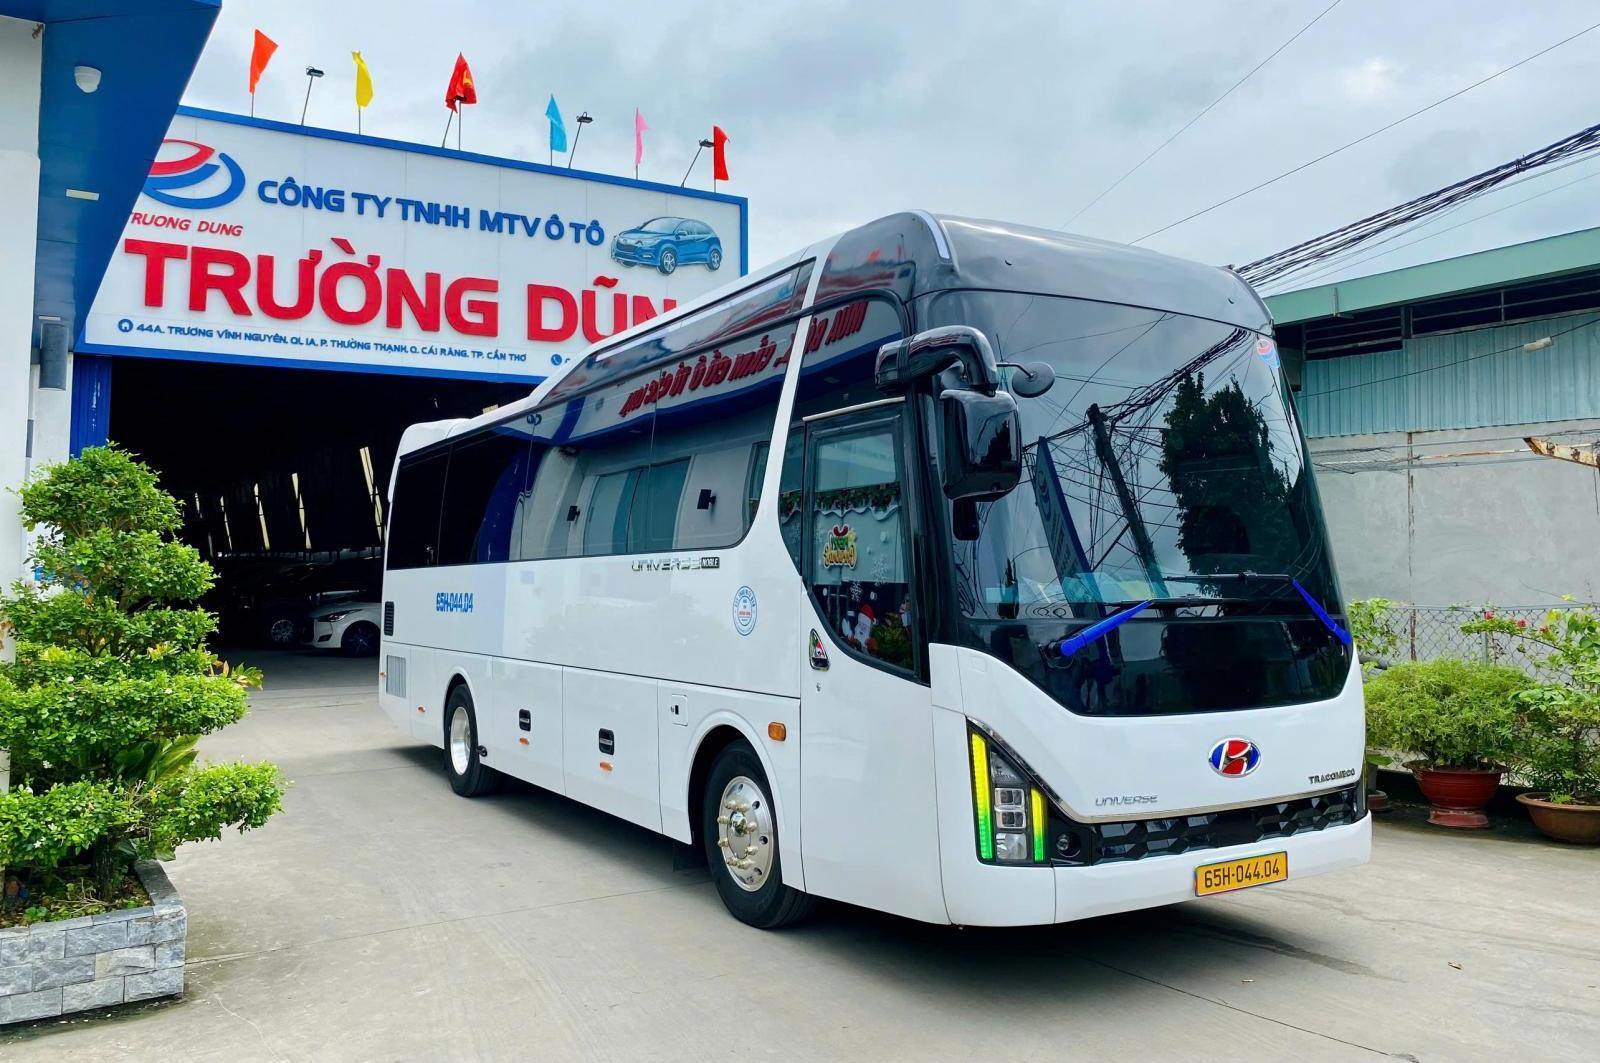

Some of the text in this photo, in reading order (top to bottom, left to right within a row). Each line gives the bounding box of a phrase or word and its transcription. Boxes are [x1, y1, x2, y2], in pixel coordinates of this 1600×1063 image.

[257, 176, 605, 246] CÔNG TY TNHH MTV Ô TÔ
[131, 212, 244, 237] RUONG DUNG
[124, 237, 498, 338] TRƯỜNG
[508, 353, 527, 362] THƠ
[631, 557, 719, 572] UNIVERSE NOBLE
[1308, 768, 1356, 785] TRACOMECO
[1095, 794, 1158, 807] UNIVERSE
[1204, 858, 1280, 889] 65H-044.04
